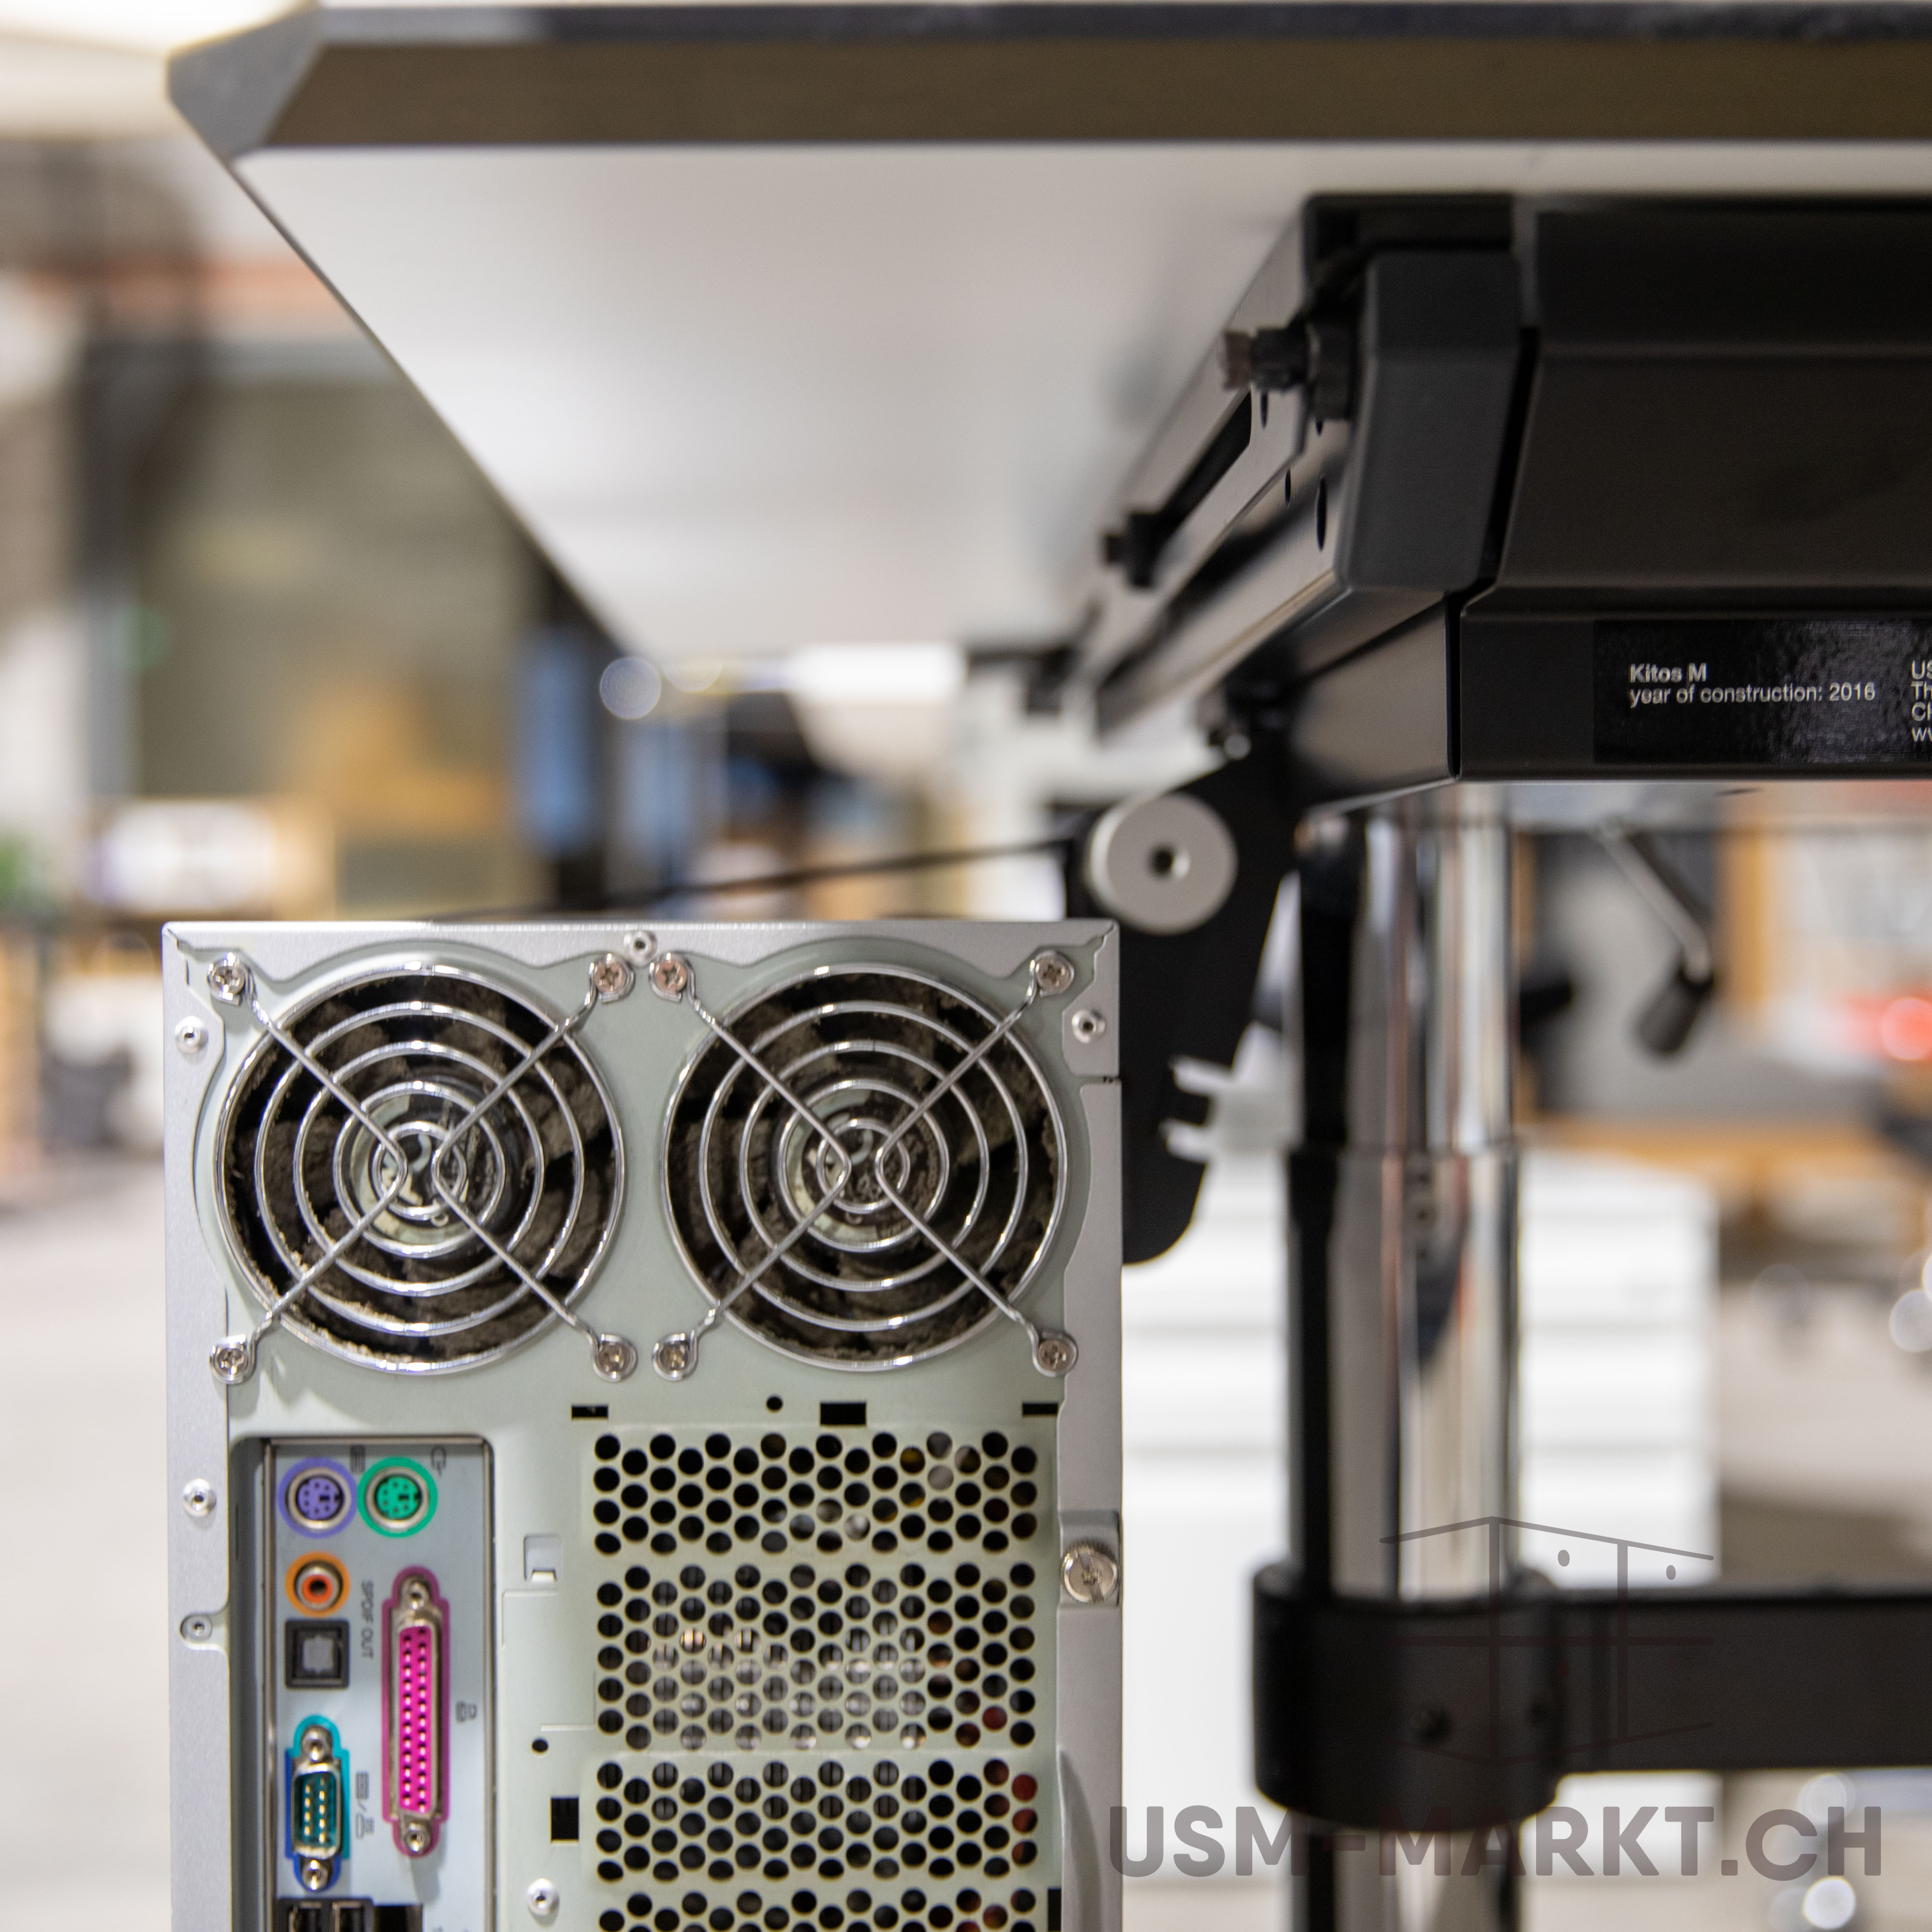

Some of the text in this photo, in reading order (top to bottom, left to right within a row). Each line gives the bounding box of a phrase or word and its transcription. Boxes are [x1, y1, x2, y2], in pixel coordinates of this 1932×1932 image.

[1630, 662, 1707, 683] Kitos M
[1630, 681, 1876, 708] year of construction: 2016
[361, 1628, 374, 1659] OUT
